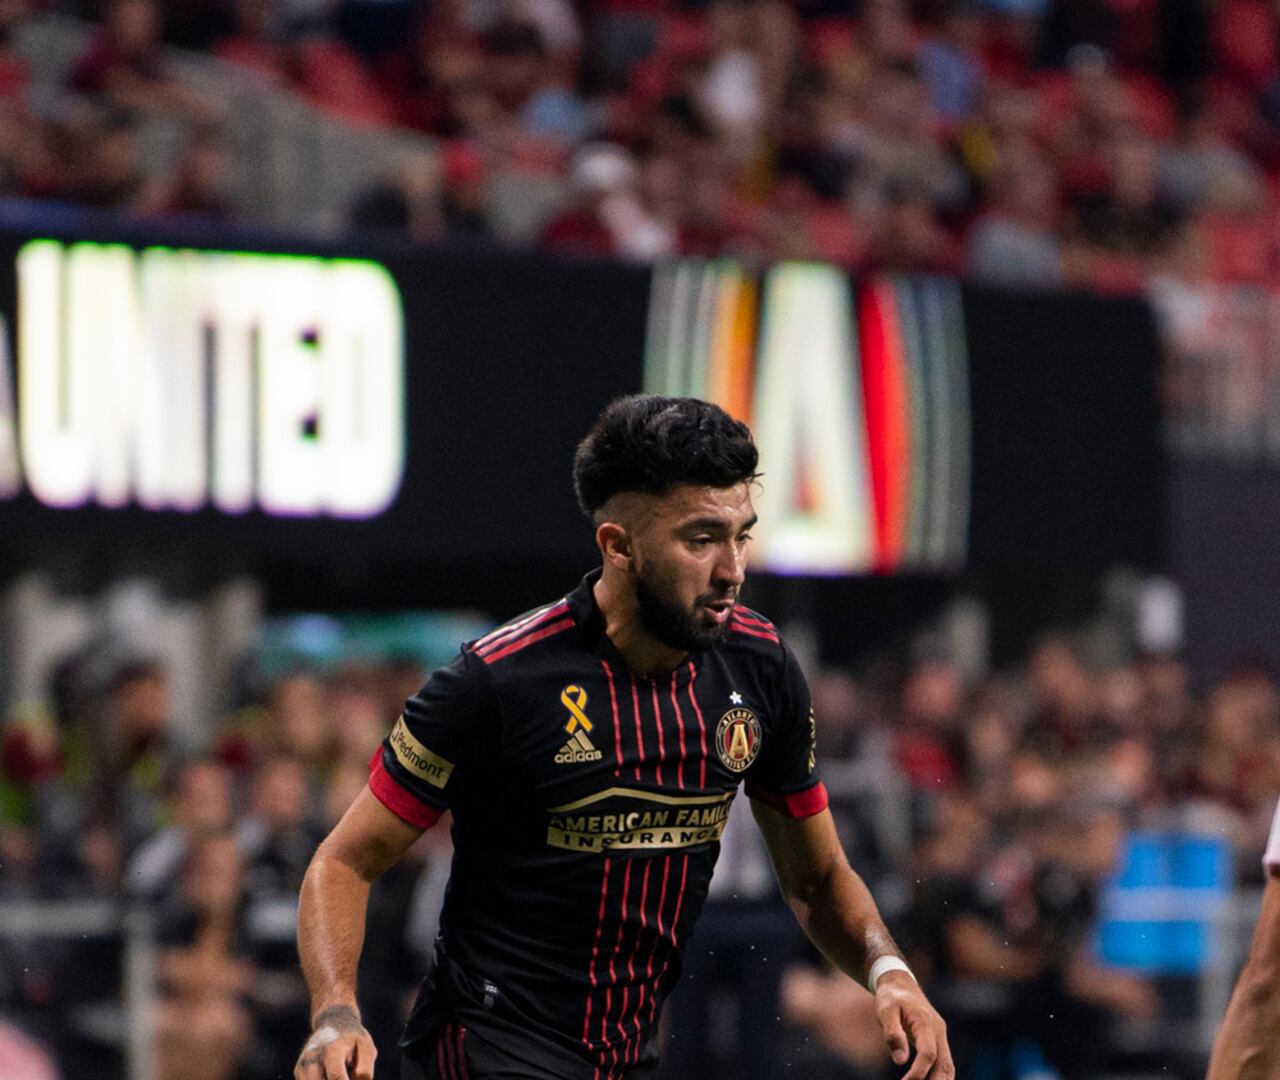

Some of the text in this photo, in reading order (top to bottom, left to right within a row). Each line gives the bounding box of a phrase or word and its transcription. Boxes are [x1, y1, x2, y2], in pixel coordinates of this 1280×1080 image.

[17, 238, 407, 520] UNITED
[722, 710, 755, 727] ATLANTA
[396, 731, 445, 780] Piedmont
[554, 750, 603, 763] adidas
[549, 803, 729, 832] AMERICAN FAMIL
[564, 828, 719, 848] INSURANCE
